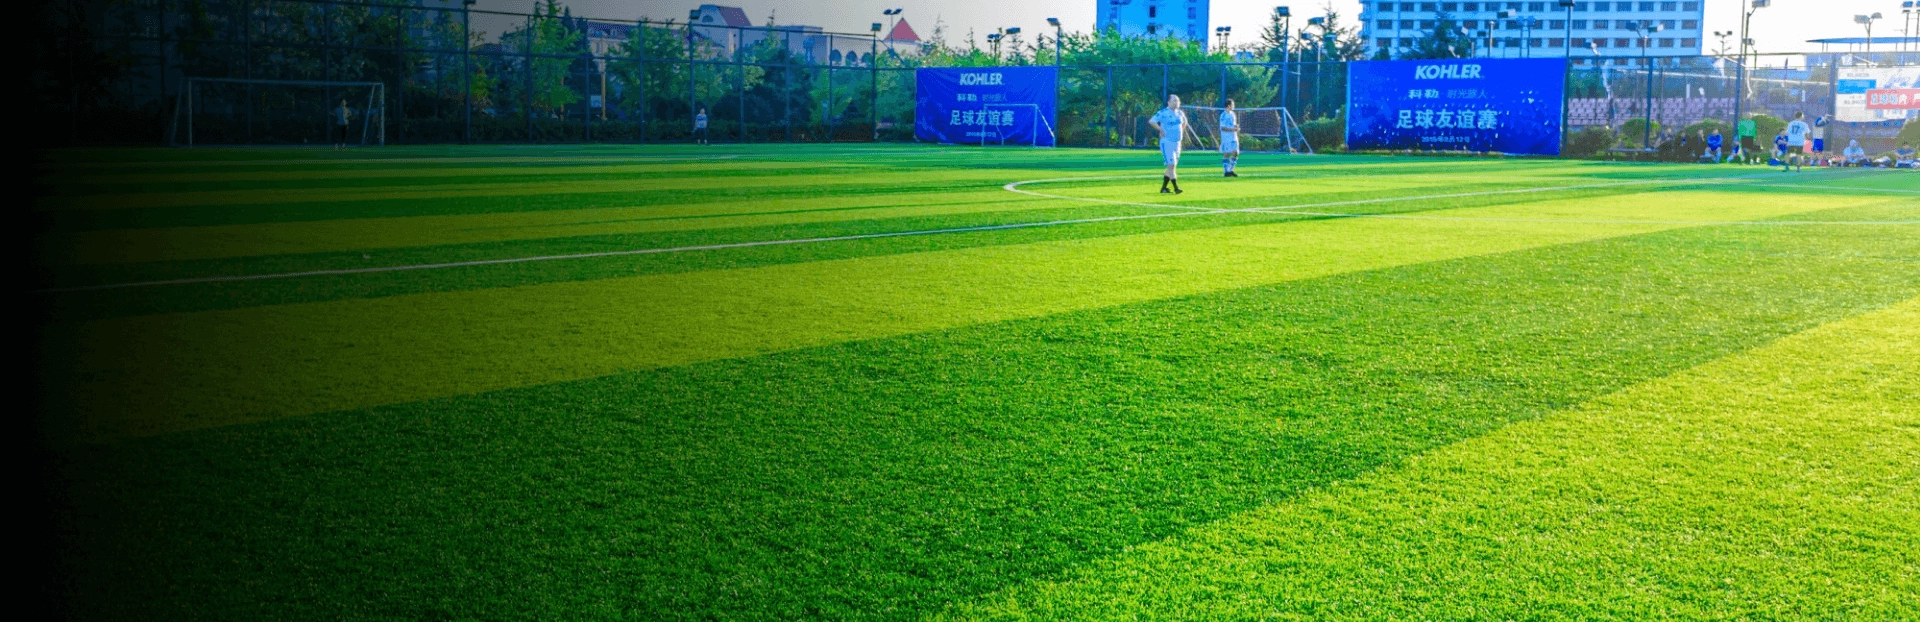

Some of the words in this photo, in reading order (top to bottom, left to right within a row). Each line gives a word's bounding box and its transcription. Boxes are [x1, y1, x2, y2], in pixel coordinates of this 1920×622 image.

[1414, 64, 1482, 79] KOHLER
[960, 73, 1003, 85] KOHLER
[1408, 88, 1440, 99] 科勒
[950, 110, 1015, 126] 足球友谊赛
[1396, 109, 1498, 130] 足球友谊赛
[1792, 125, 1800, 134] 17
